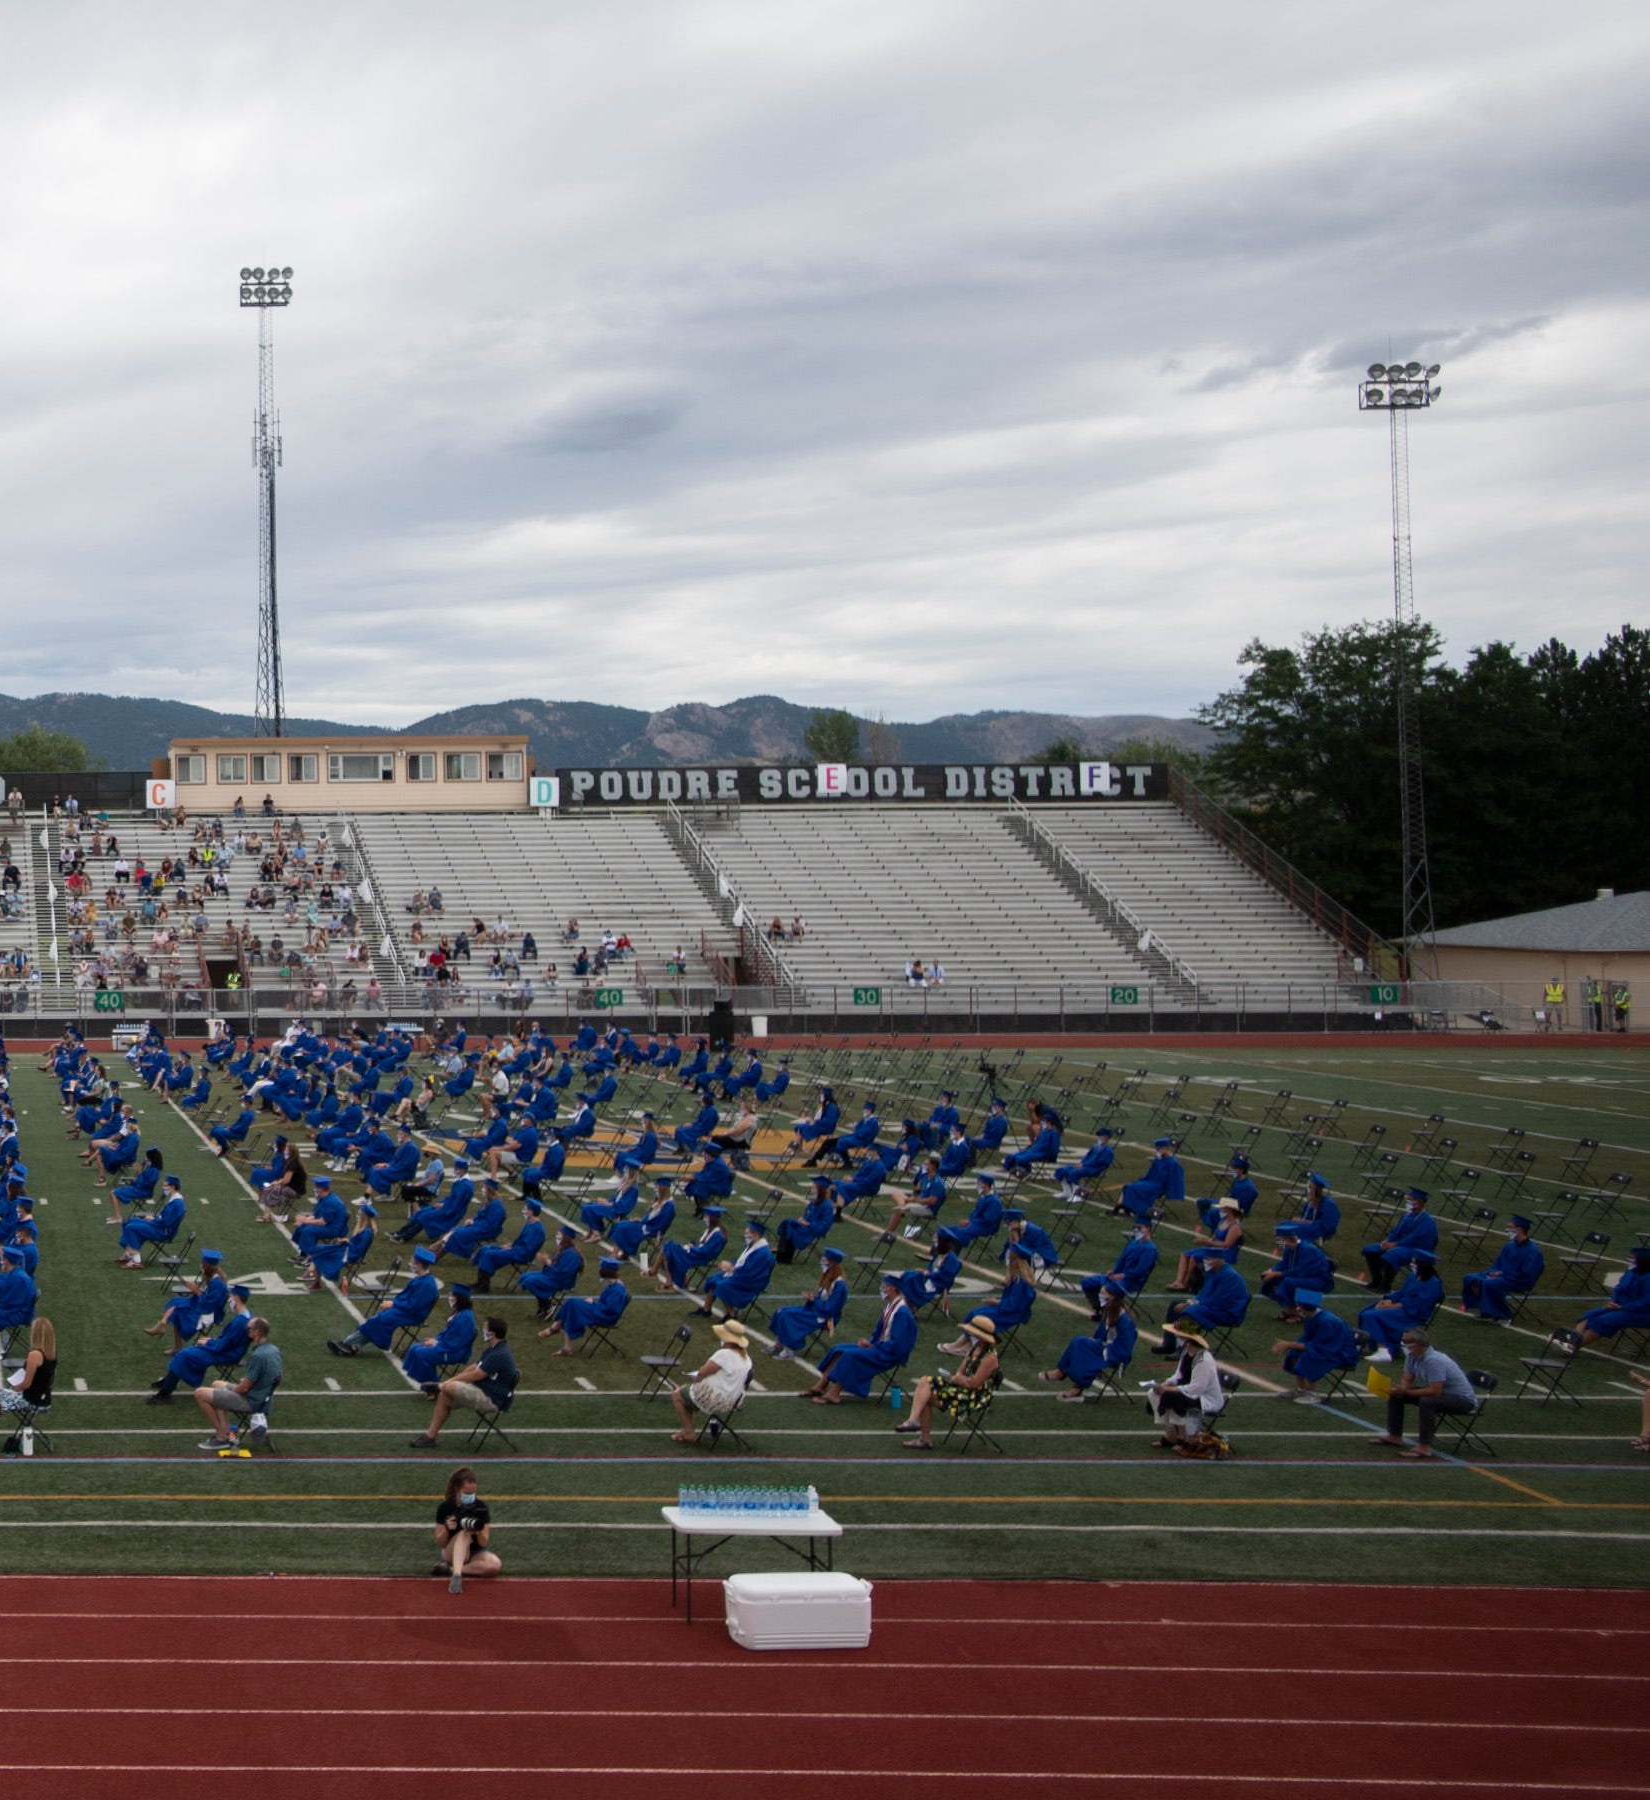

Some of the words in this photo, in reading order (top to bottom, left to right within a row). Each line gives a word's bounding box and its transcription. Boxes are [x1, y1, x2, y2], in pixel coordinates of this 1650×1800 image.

[570, 770, 739, 801] POUDRE
[758, 766, 925, 798] SCOOL
[944, 765, 1152, 797] DISTRCT
[826, 766, 838, 790] E
[1088, 765, 1101, 788] F
[152, 783, 166, 806] C
[537, 780, 552, 803] D
[100, 993, 119, 1008] 40
[600, 991, 619, 1005] 40
[857, 989, 876, 1004] 30
[1114, 988, 1134, 1003] 20
[1378, 987, 1393, 1002] 10
